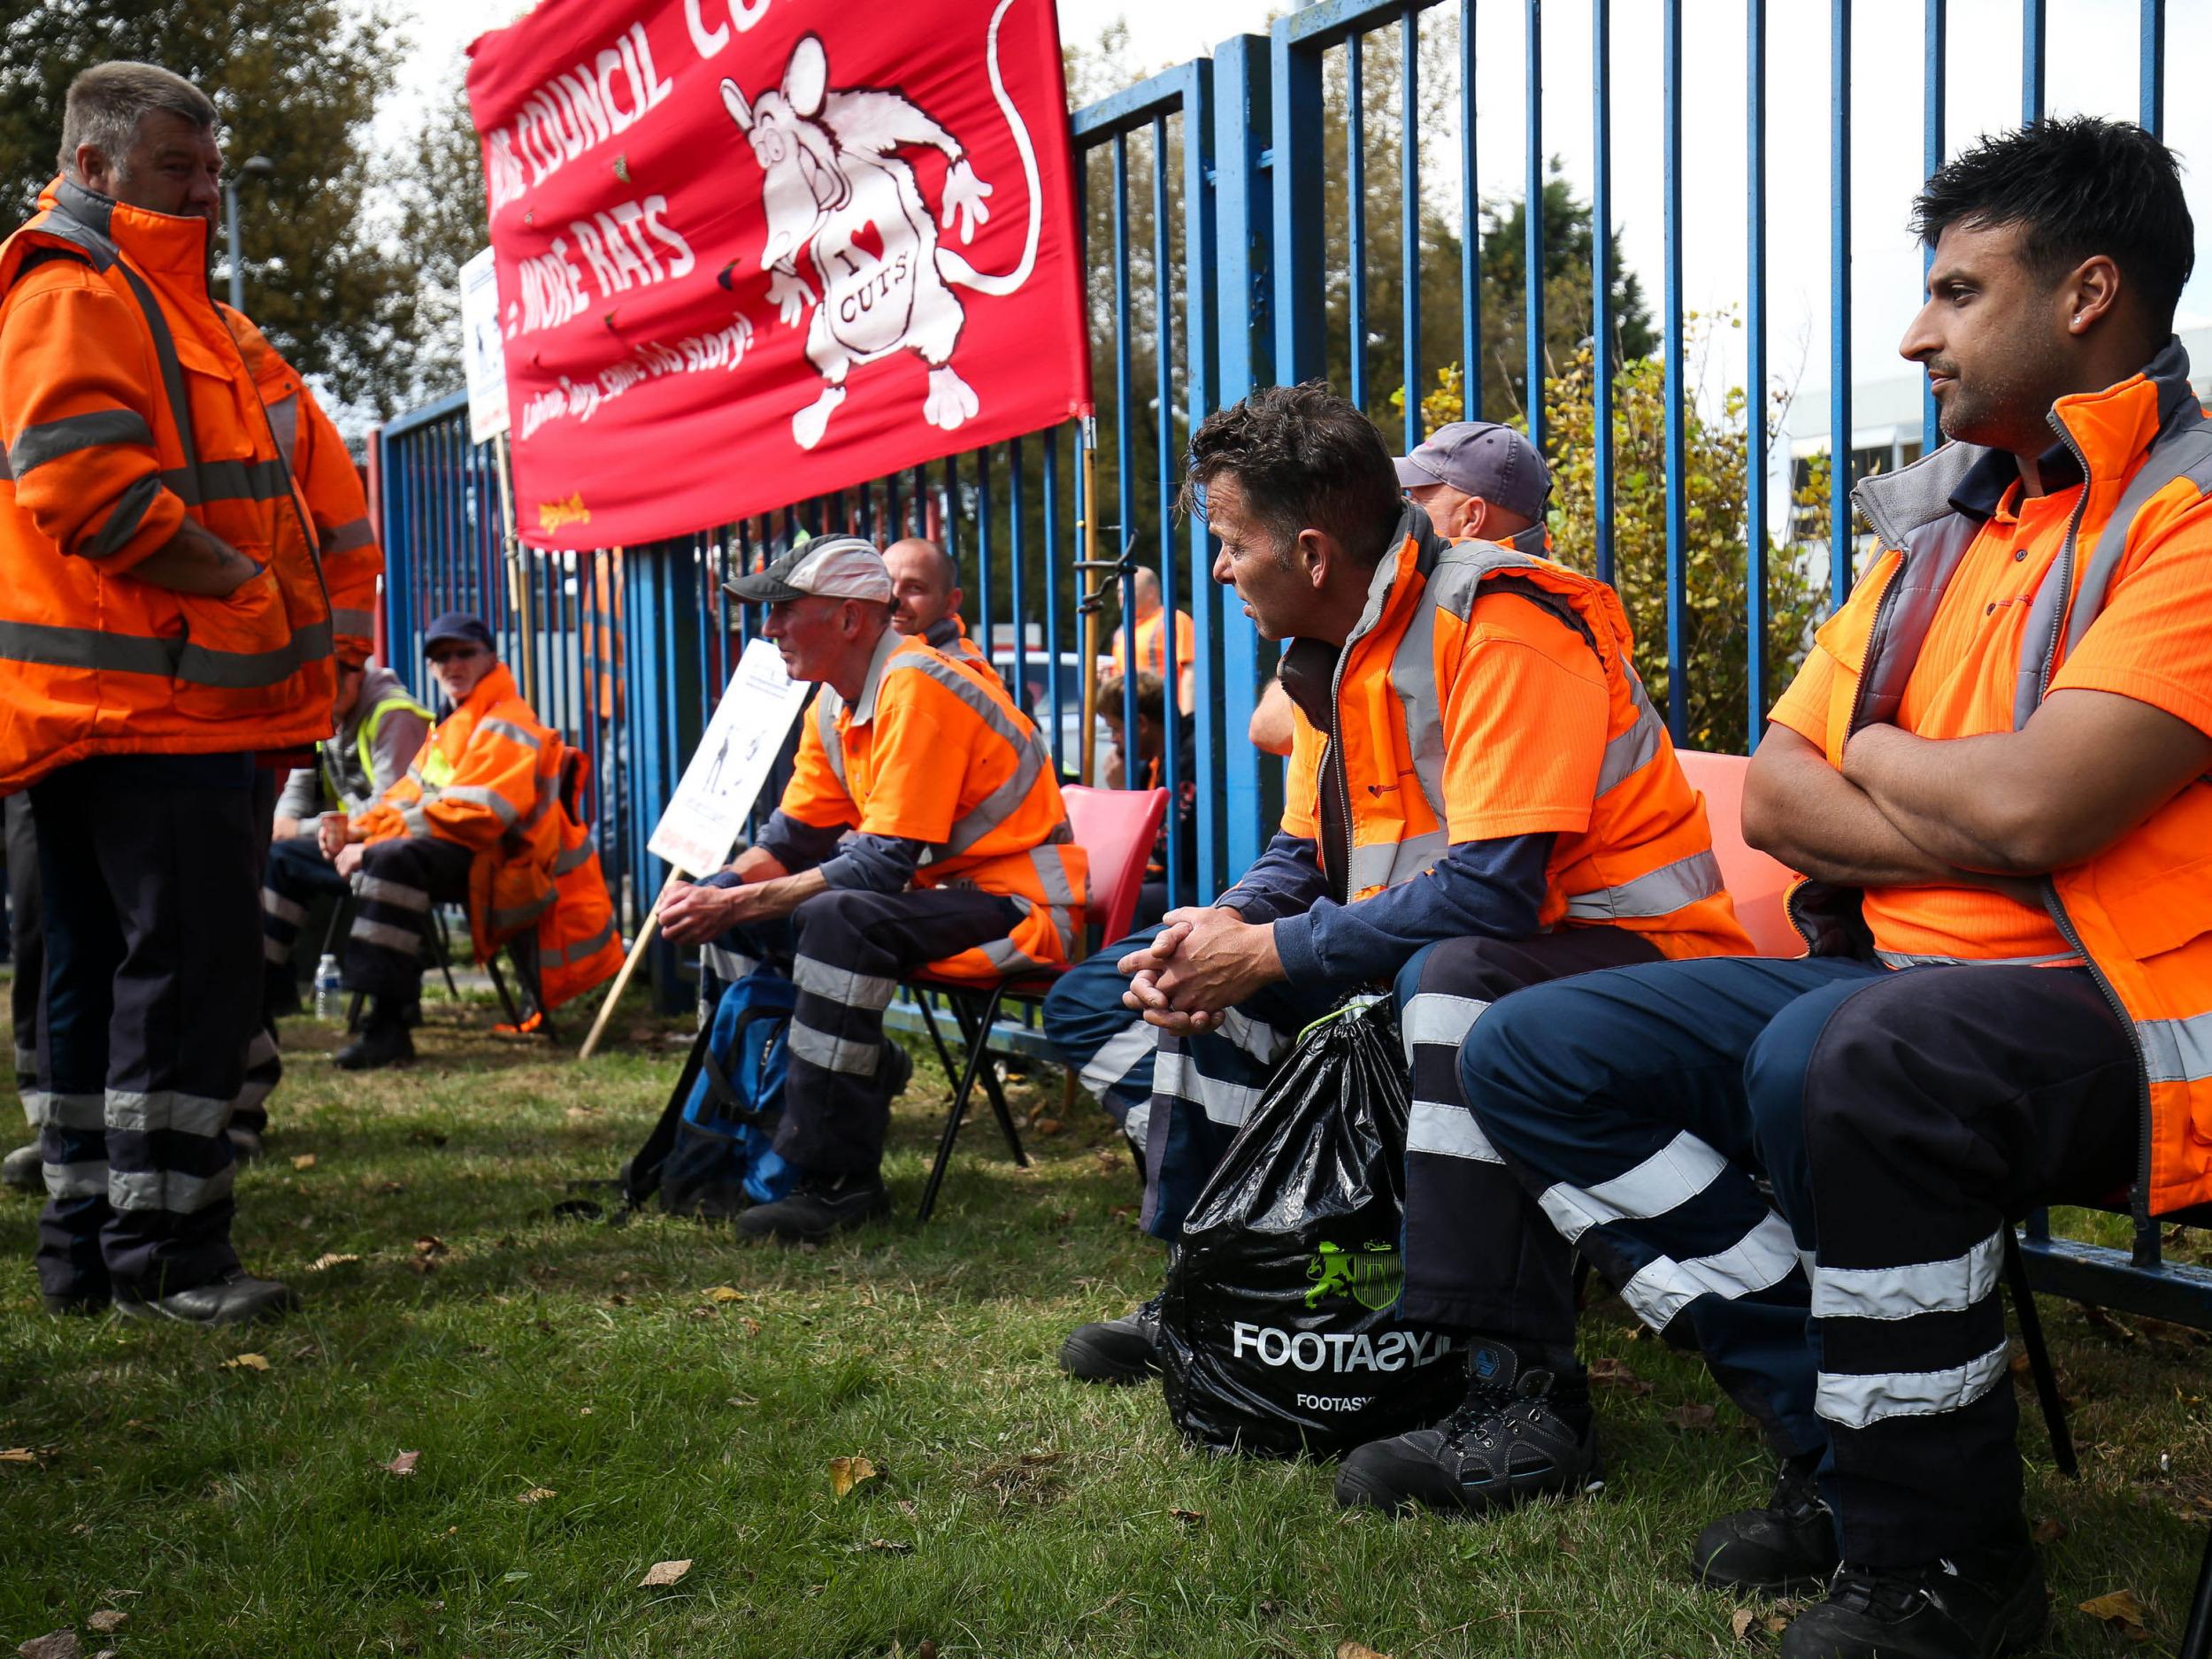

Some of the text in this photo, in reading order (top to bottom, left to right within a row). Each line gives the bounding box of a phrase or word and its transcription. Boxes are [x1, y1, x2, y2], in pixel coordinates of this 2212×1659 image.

[515, 21, 672, 188] COUNCIL
[569, 195, 695, 298] RATS
[833, 250, 860, 277] I
[841, 250, 908, 323] CUTS
[677, 311, 755, 373] story!
